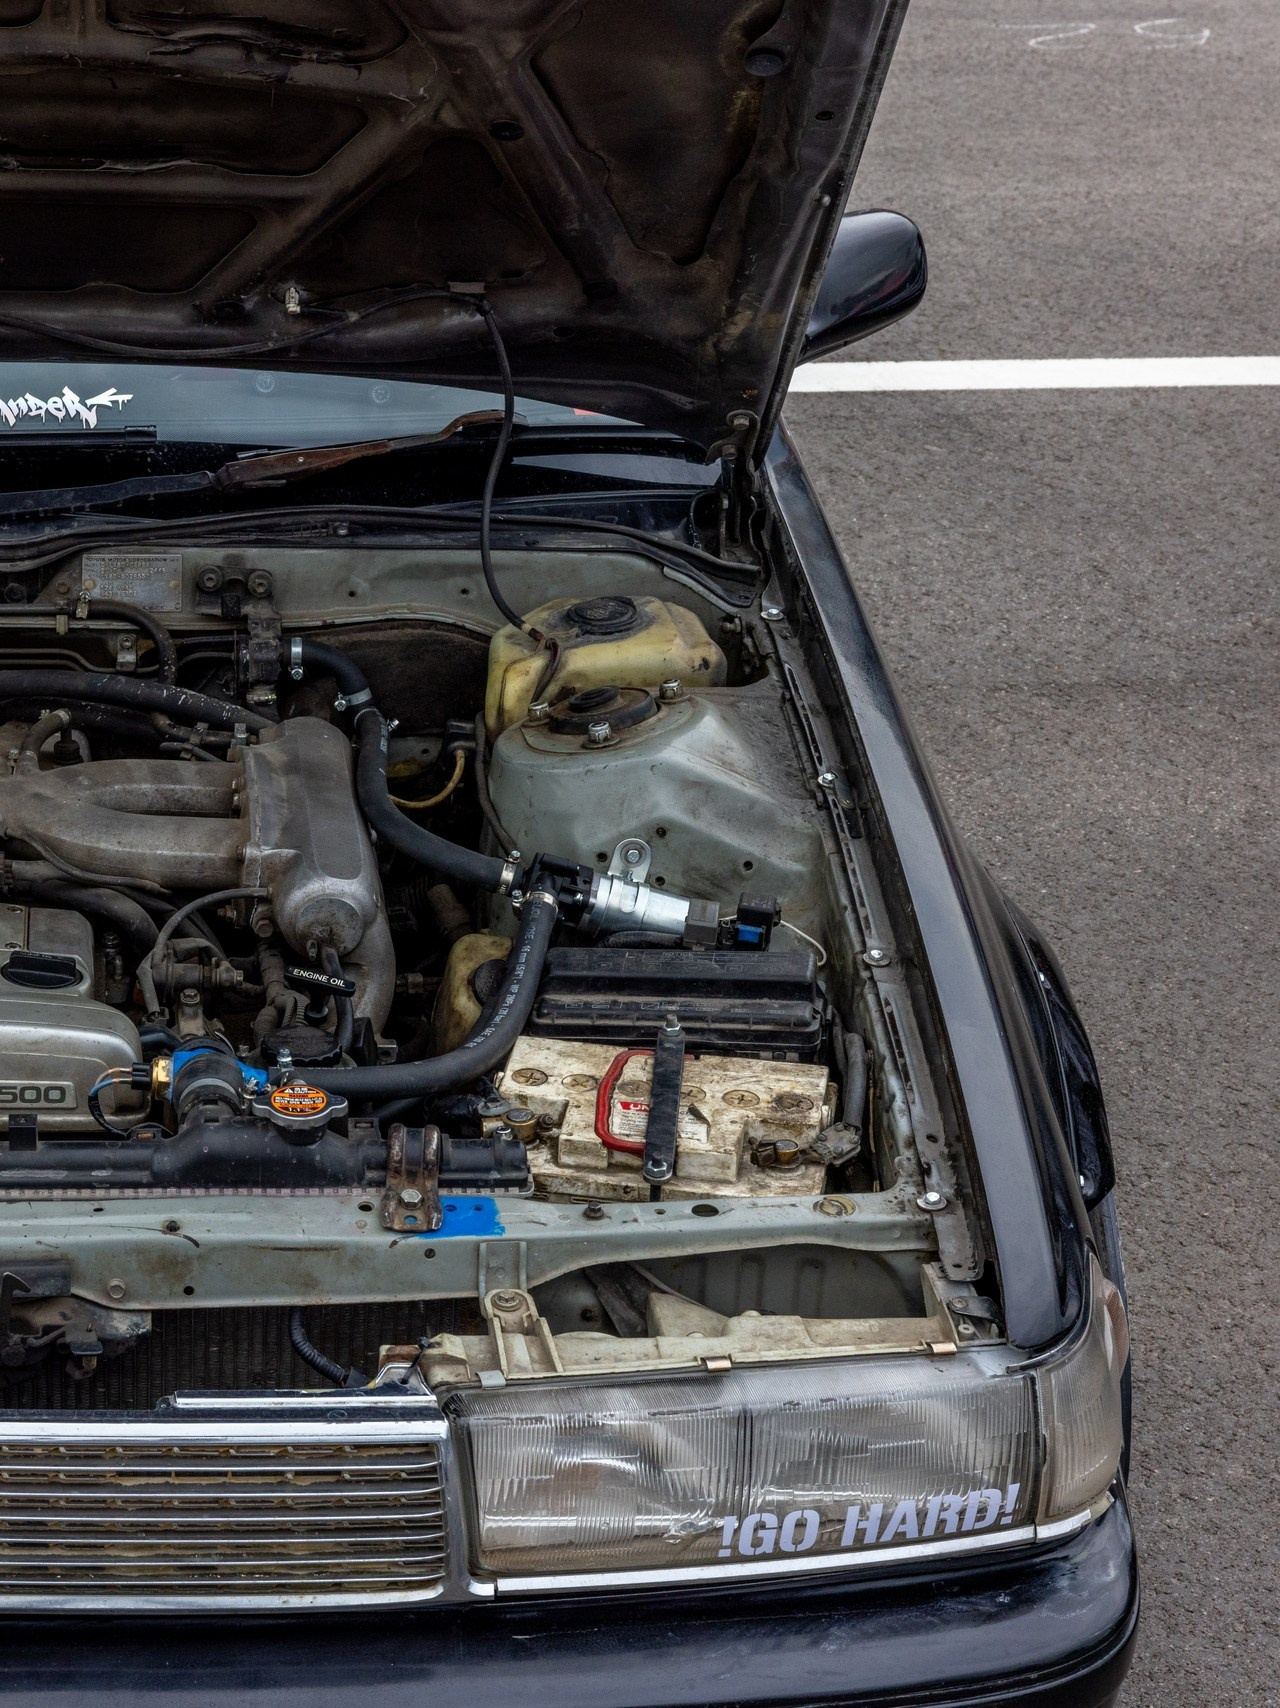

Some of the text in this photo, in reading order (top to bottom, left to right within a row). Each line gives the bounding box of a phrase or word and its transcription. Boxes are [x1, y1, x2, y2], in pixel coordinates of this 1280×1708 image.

[293, 968, 346, 988] ENGINE OIL
[840, 1483, 1021, 1548] HARD!
